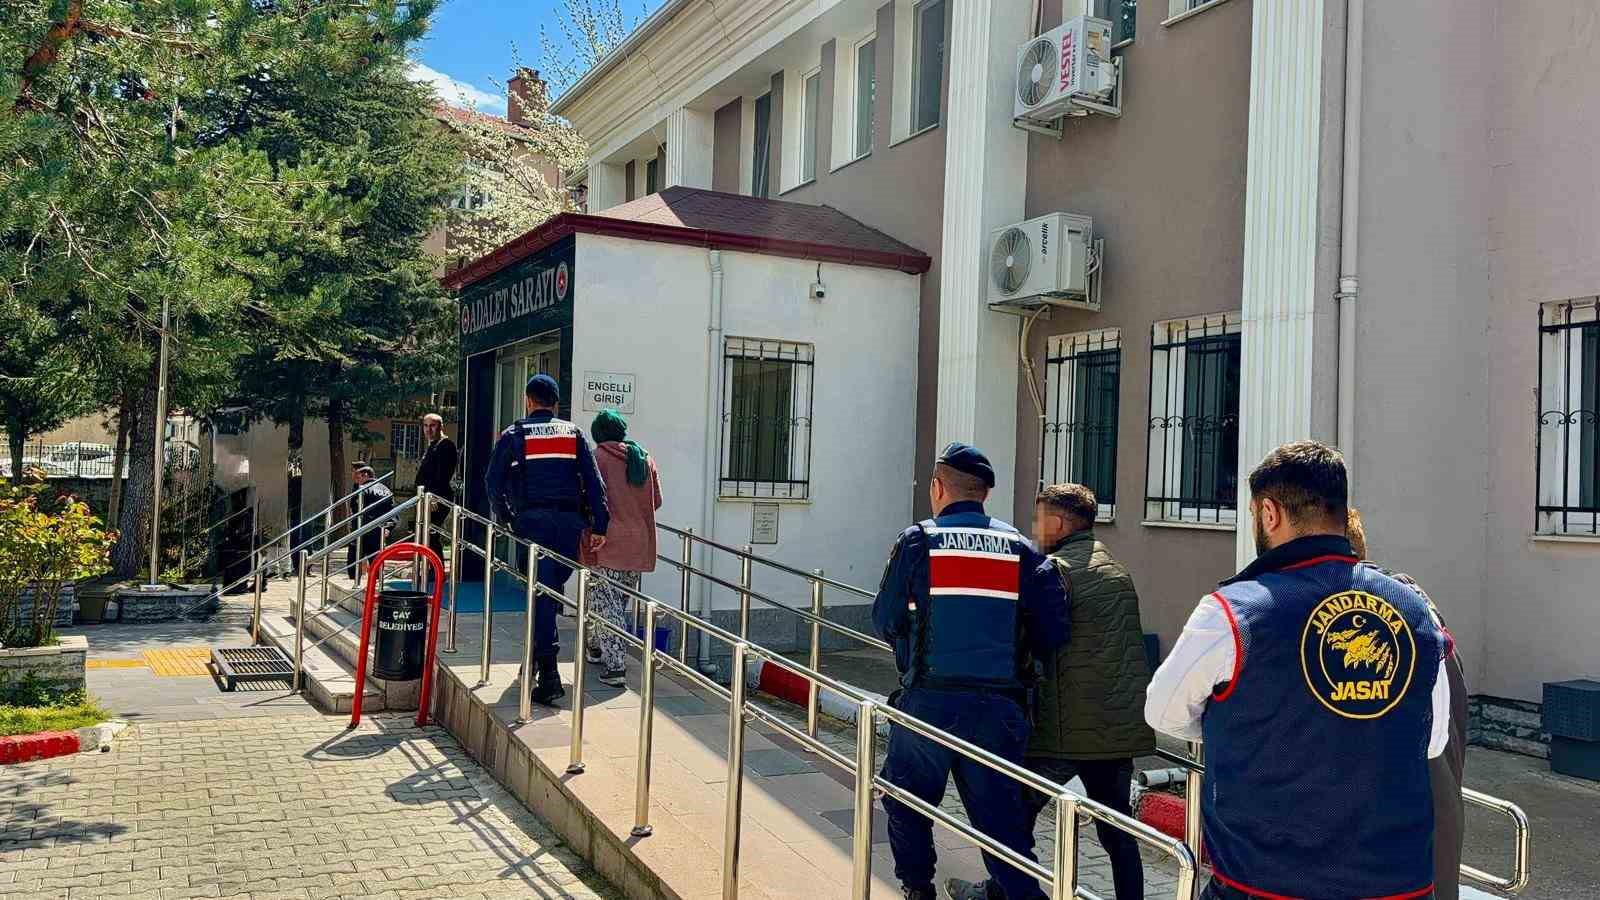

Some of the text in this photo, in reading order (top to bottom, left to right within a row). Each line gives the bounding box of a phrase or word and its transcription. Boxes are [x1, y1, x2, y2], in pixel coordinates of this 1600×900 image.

[1060, 29, 1073, 92] VESTEL
[469, 268, 555, 334] ADALET SARAYI
[588, 381, 632, 393] ENGELLİ
[593, 393, 625, 405] GİRİŞİ
[939, 532, 1012, 554] JANDARMA
[392, 611, 411, 620] ÇAY
[1312, 595, 1403, 635] JANDARMA
[1331, 680, 1391, 701] JASAT
